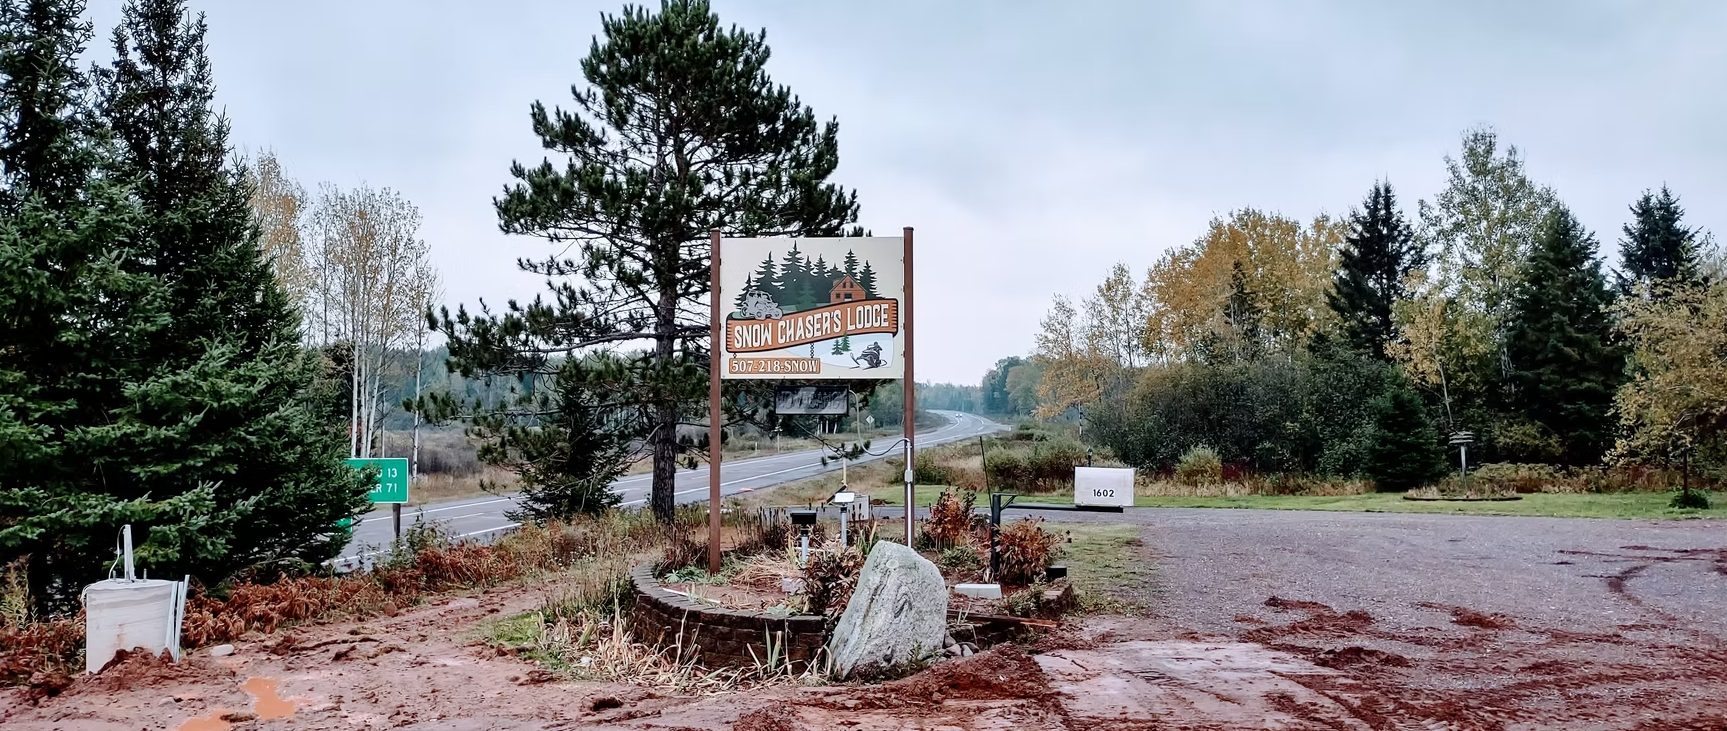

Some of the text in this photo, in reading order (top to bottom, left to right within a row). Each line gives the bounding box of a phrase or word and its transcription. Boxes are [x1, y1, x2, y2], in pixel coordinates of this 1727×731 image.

[734, 304, 889, 349] SNOW CHASER'S LODGE
[731, 360, 818, 373] 507-218-SNOW
[387, 468, 398, 478] 13
[386, 483, 398, 493] 71
[1093, 489, 1115, 498] 1602
